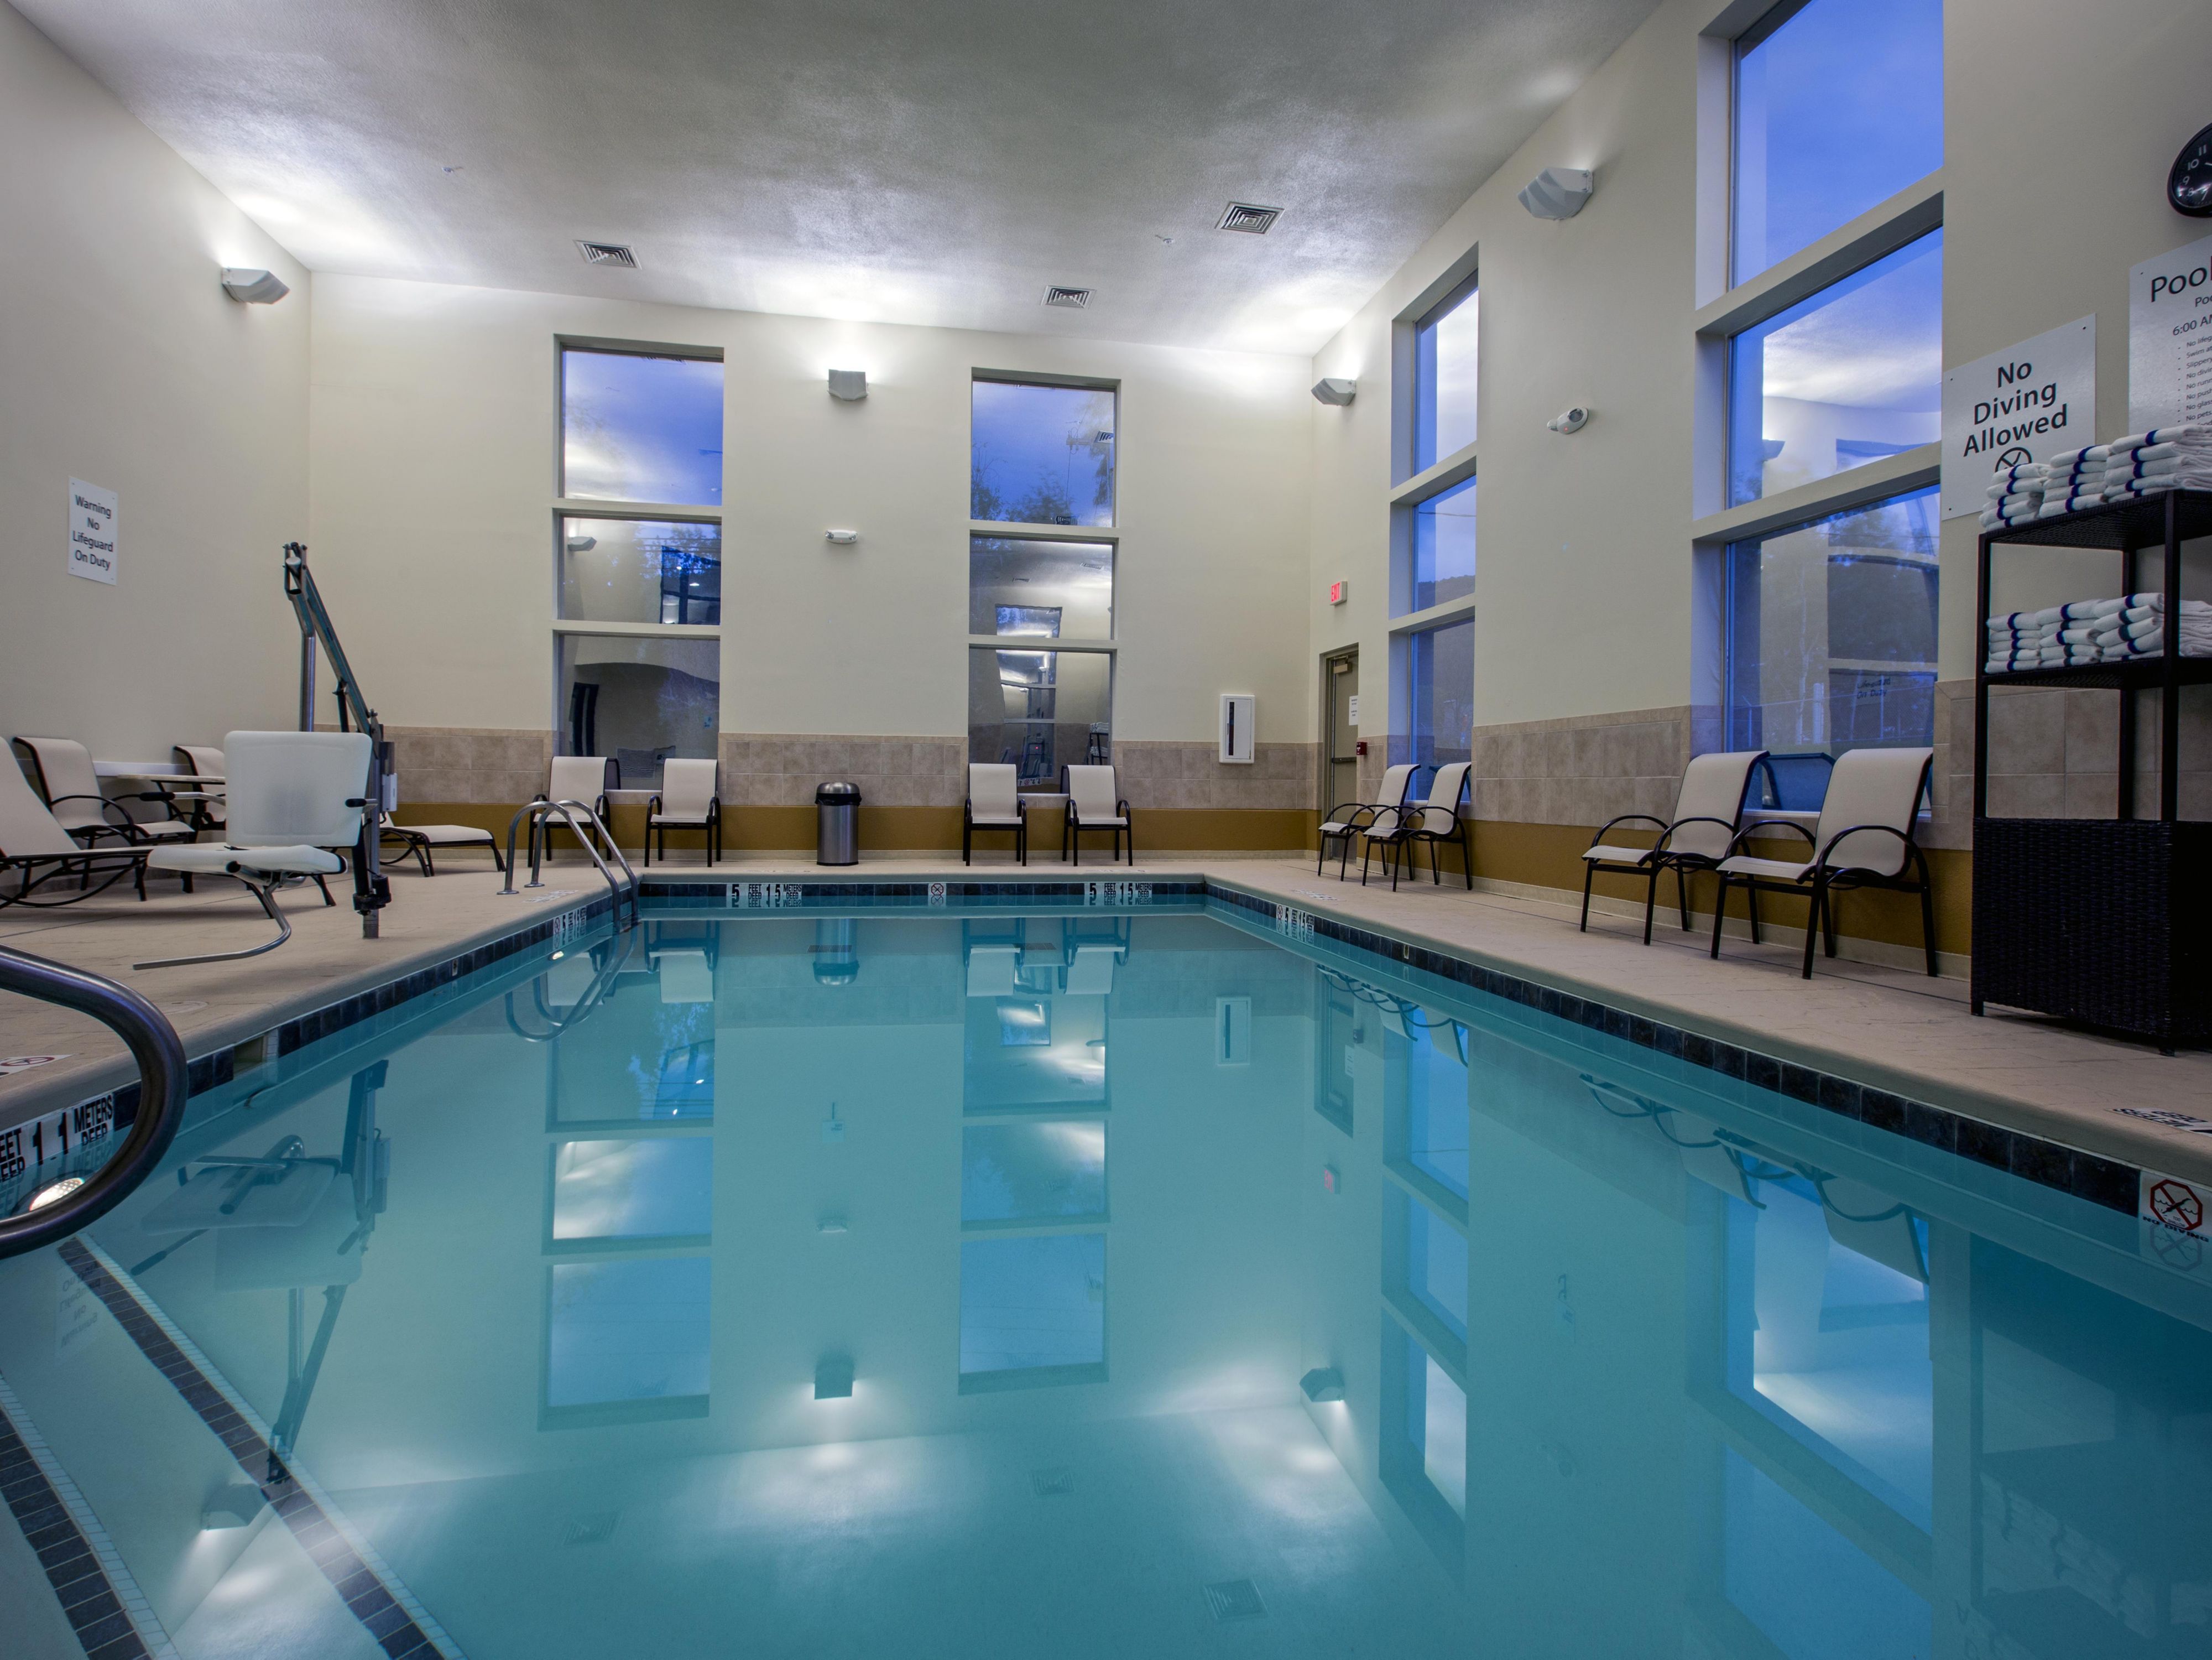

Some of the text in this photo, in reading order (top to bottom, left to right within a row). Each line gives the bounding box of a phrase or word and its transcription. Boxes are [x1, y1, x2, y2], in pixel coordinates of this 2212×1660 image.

[2199, 144, 2206, 156] 11
[2188, 159, 2199, 170] 10
[2183, 176, 2190, 185] 9
[2173, 320, 2197, 336] 6:00
[2186, 349, 2204, 358] Swim
[1997, 362, 2032, 388] No
[1974, 382, 2057, 425] Diving
[1963, 403, 2067, 457] Allowed
[75, 495, 112, 519] Warning
[87, 517, 100, 530] No
[72, 530, 113, 553] Lifeguard
[75, 549, 111, 571] On Duty
[1331, 582, 1340, 602] EXIT
[783, 884, 802, 892] METERS
[74, 1094, 113, 1133] METERS
[2113, 1109, 2194, 1127] METERS
[2151, 1111, 2208, 1123] DEEP
[2143, 1216, 2209, 1242] NO DIVING
